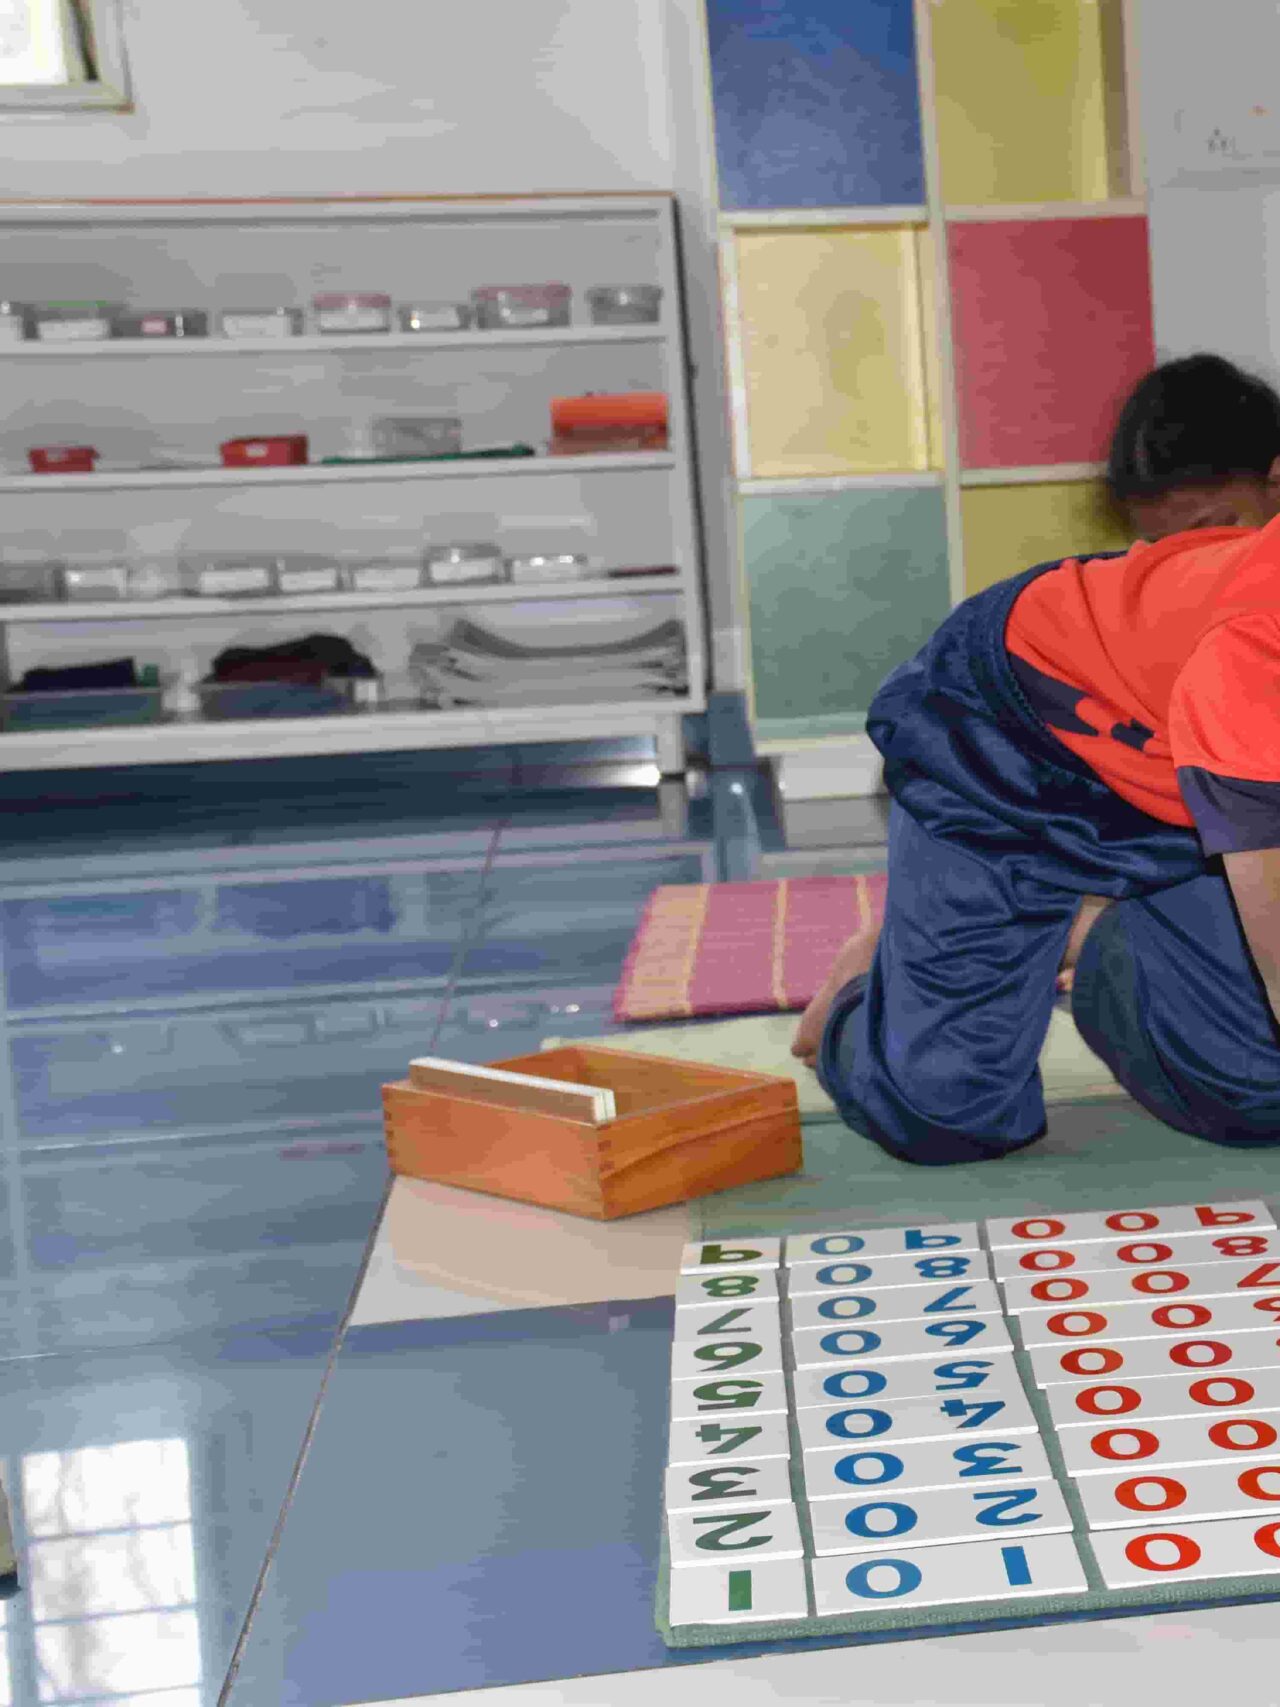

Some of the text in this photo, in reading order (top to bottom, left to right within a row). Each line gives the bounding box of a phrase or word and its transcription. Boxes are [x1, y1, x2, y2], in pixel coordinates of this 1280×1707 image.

[700, 1244, 762, 1265] 9
[701, 1275, 759, 1297] 8
[697, 1307, 753, 1335] 7
[693, 1341, 762, 1372] 6
[693, 1380, 763, 1411] 5
[695, 1423, 763, 1454] 4
[688, 1466, 760, 1501] 3
[692, 1510, 773, 1551] 2
